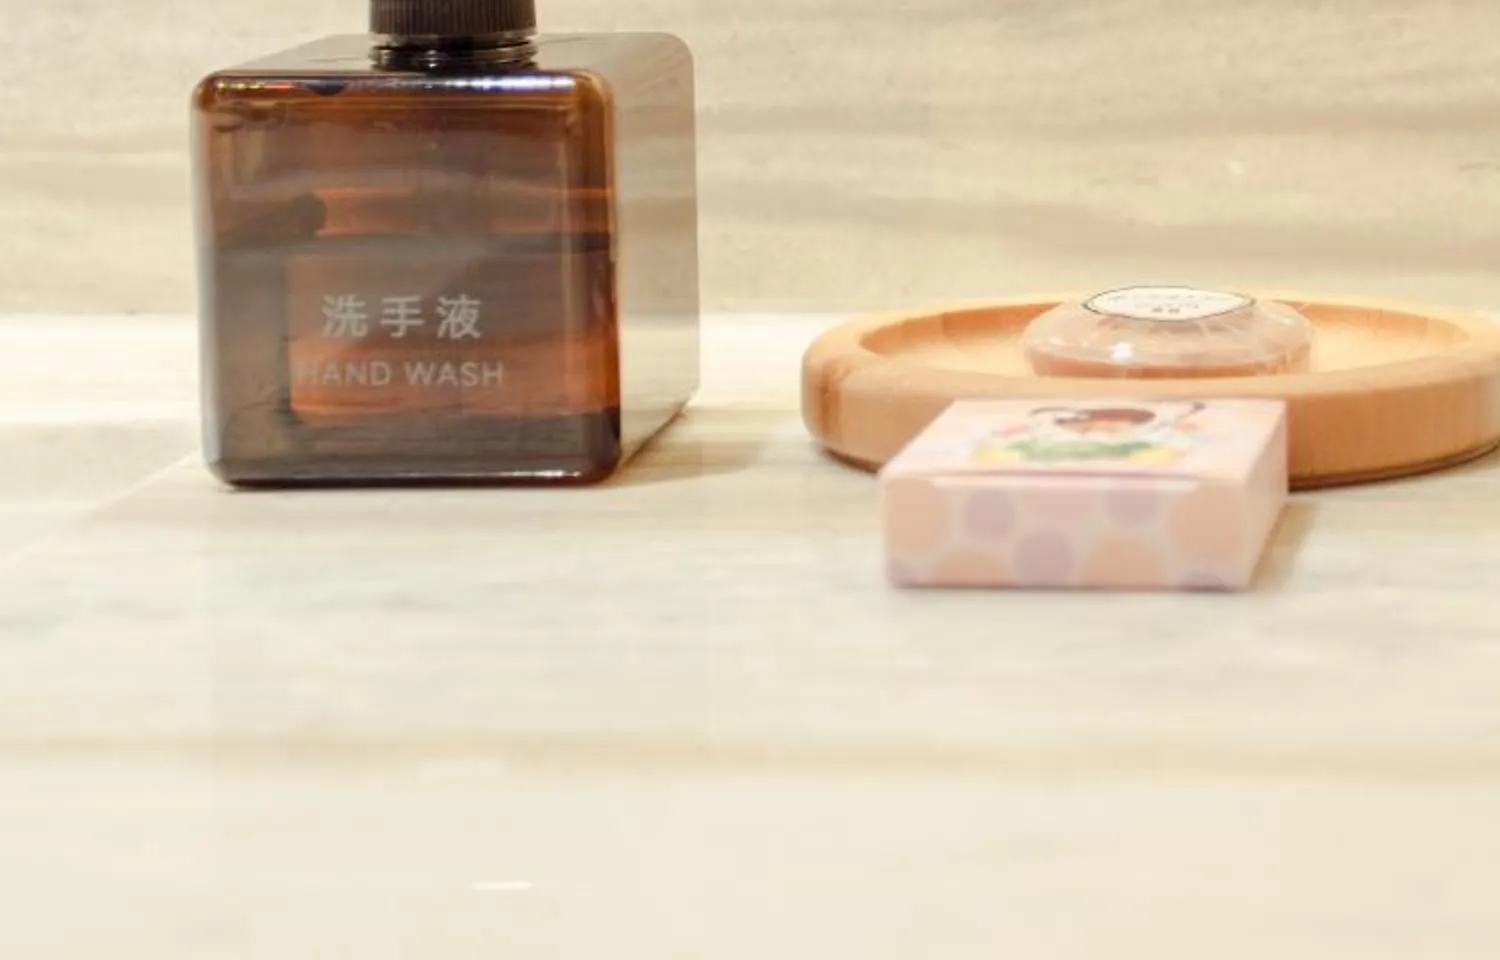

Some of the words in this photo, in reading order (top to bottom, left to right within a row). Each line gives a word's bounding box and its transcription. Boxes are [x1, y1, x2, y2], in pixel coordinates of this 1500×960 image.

[320, 293, 483, 339] 洗手液
[299, 361, 392, 387] HAND
[405, 361, 505, 387] WASH
